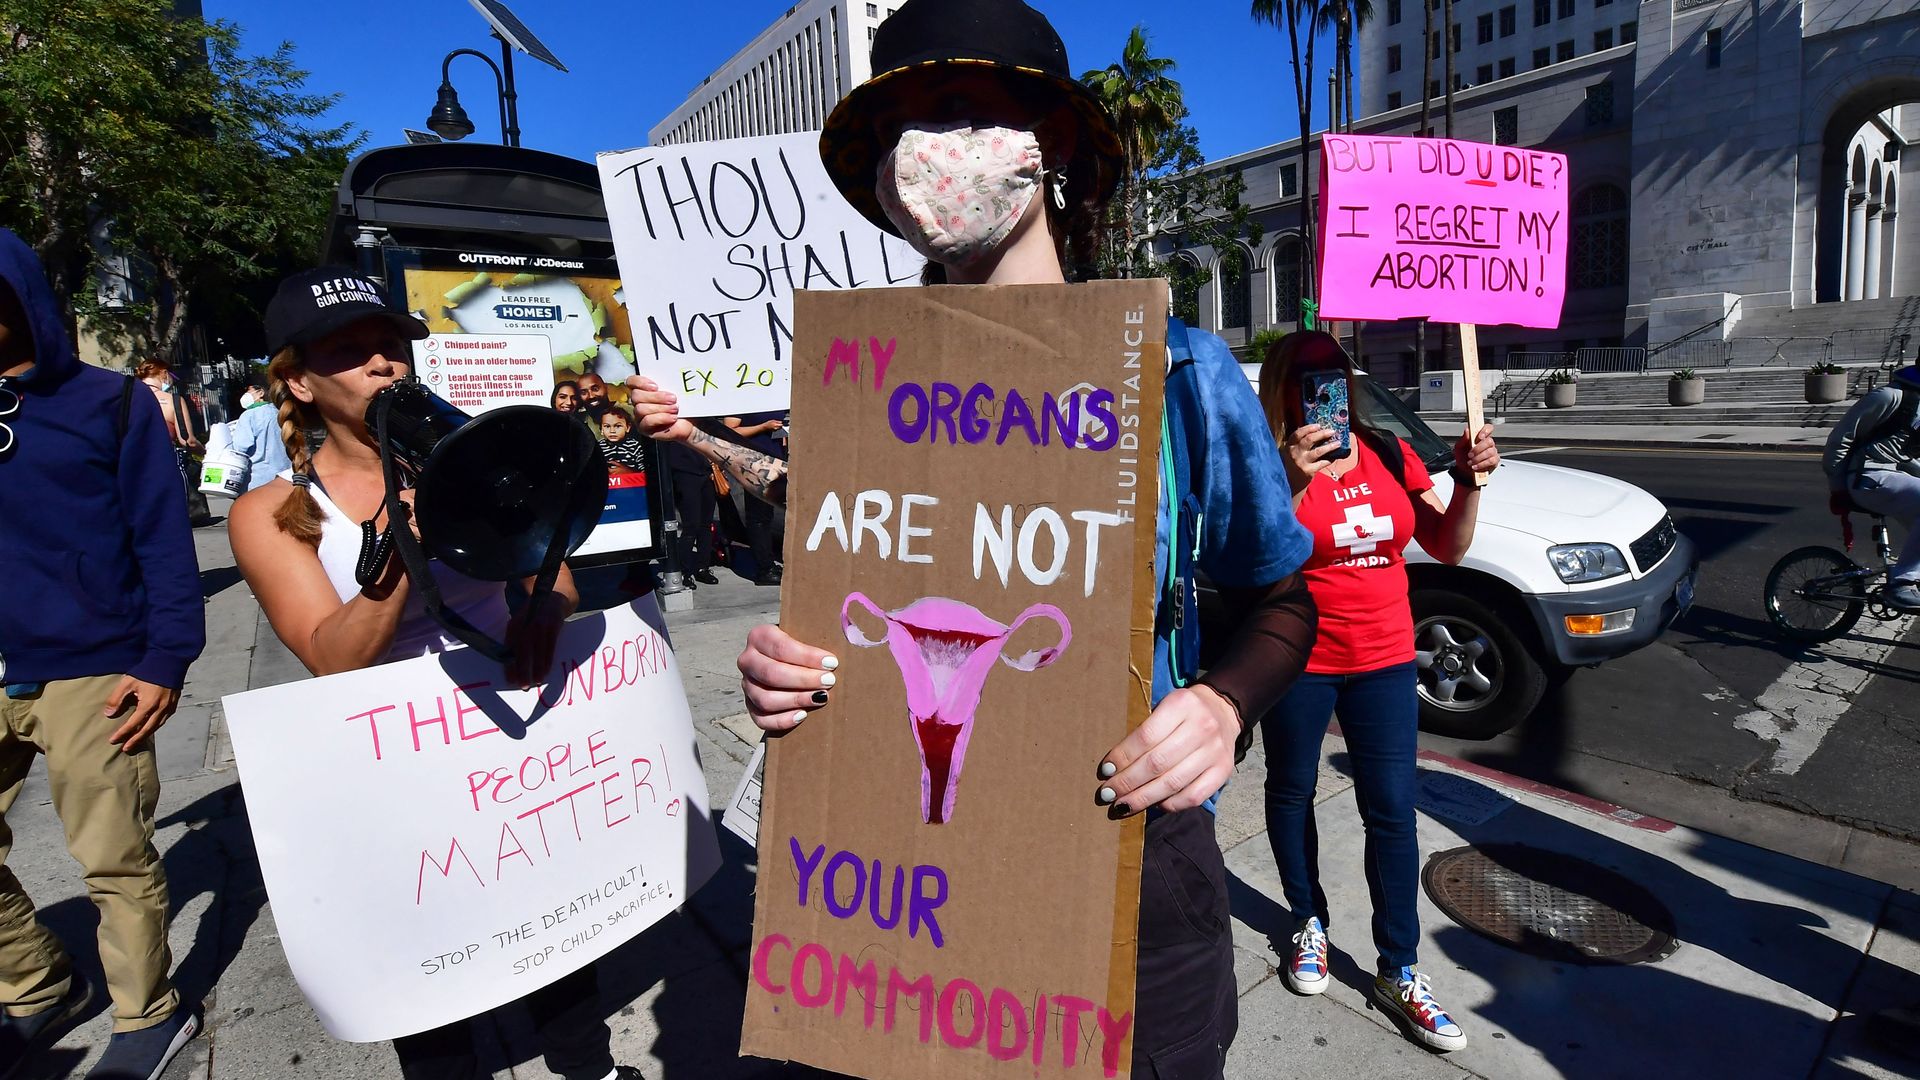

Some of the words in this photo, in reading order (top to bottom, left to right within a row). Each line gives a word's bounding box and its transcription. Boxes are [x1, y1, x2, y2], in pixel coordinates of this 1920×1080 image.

[1327, 138, 1402, 173] BUT
[1476, 149, 1492, 180] U
[614, 146, 805, 241] THOU
[1336, 205, 1370, 239] I
[1394, 202, 1509, 244] REGRET
[1517, 210, 1560, 254] MY
[1686, 244, 1705, 252] CITY
[458, 253, 527, 266] OUTFRONT
[533, 257, 585, 269] JCDecaux
[712, 230, 921, 301] SHALL
[1370, 251, 1544, 298] ABORTION!
[310, 277, 376, 297] DEFUND
[316, 293, 340, 308] GUN
[340, 290, 386, 307] CONTROL
[501, 296, 526, 304] LEAD
[528, 296, 551, 304] FREE
[502, 306, 553, 319] HOMES
[647, 302, 741, 360] NOT
[444, 340, 480, 351] Chipped
[481, 341, 508, 351] paint?
[446, 358, 462, 366] Live
[464, 358, 472, 366] in
[508, 358, 537, 366] home?
[822, 335, 896, 393] MY
[448, 374, 469, 382] Lead
[470, 374, 492, 383] paint
[449, 382, 483, 390] serious
[449, 390, 484, 398] children
[486, 390, 504, 398] and
[506, 389, 544, 399] pregnant
[681, 370, 719, 396] EX
[450, 399, 485, 407] women.
[888, 381, 1119, 452] ORGANS
[1116, 303, 1144, 523] FLUIDSTANCE
[1333, 482, 1373, 503] LIFE
[806, 489, 940, 564] ARE
[972, 501, 1125, 598] NOT
[345, 681, 501, 760] THE
[537, 625, 668, 708] UNBORN
[467, 729, 616, 811] PEOPLE
[417, 744, 680, 905] MATTER!
[789, 835, 948, 948] YOUR
[421, 943, 480, 975] STOP
[492, 921, 536, 949] THE
[543, 892, 601, 930] DEATH
[603, 864, 648, 899] CULT!
[512, 945, 554, 975] STOP
[560, 923, 603, 954] CHILD
[607, 879, 674, 927] SACRIFICE!
[753, 932, 1132, 1078] COMMODITY
